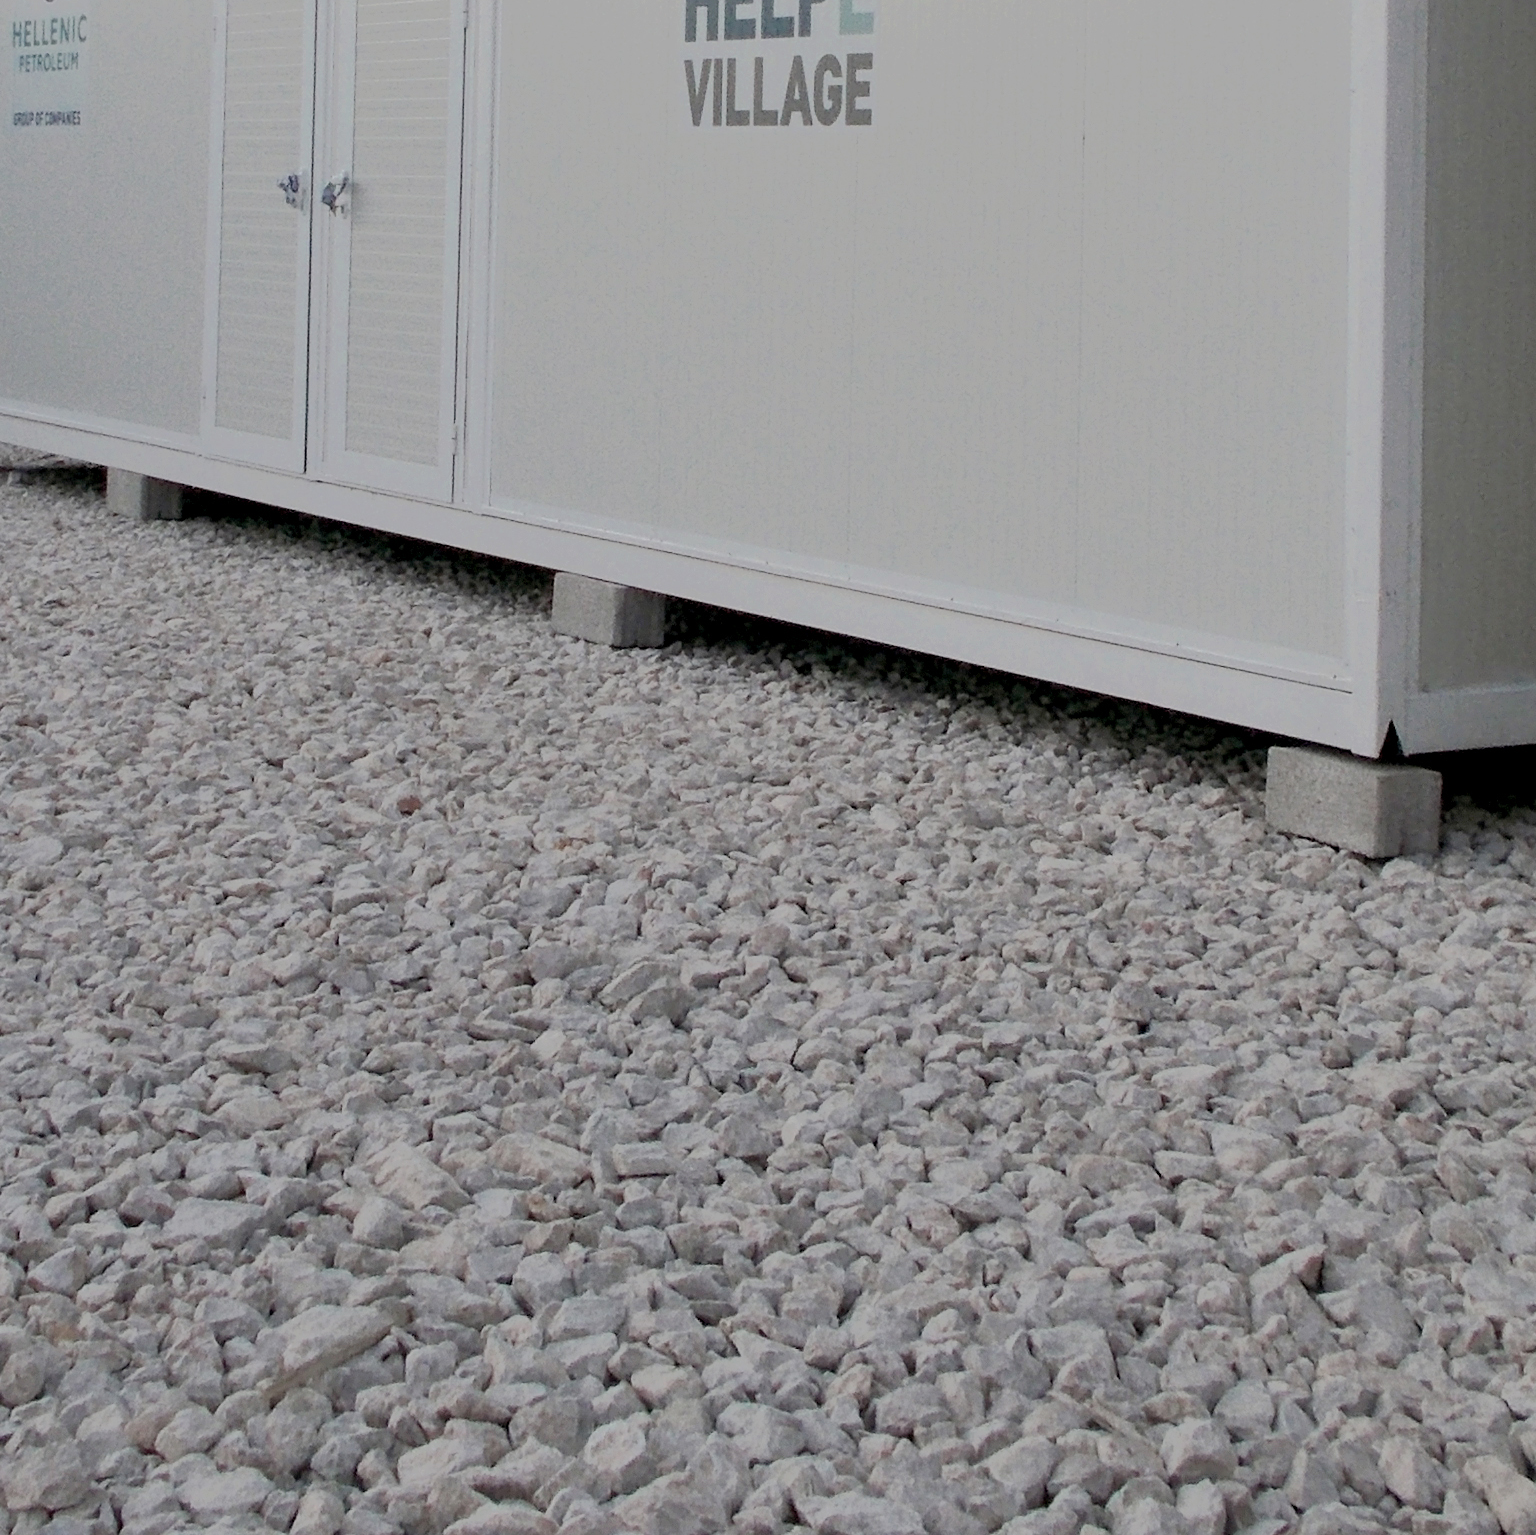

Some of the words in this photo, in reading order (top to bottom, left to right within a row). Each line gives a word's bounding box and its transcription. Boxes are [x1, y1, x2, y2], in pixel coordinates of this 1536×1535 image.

[12, 14, 87, 47] HELLENIC
[19, 52, 79, 73] PETROLEUM
[684, 52, 874, 127] VILLAGE
